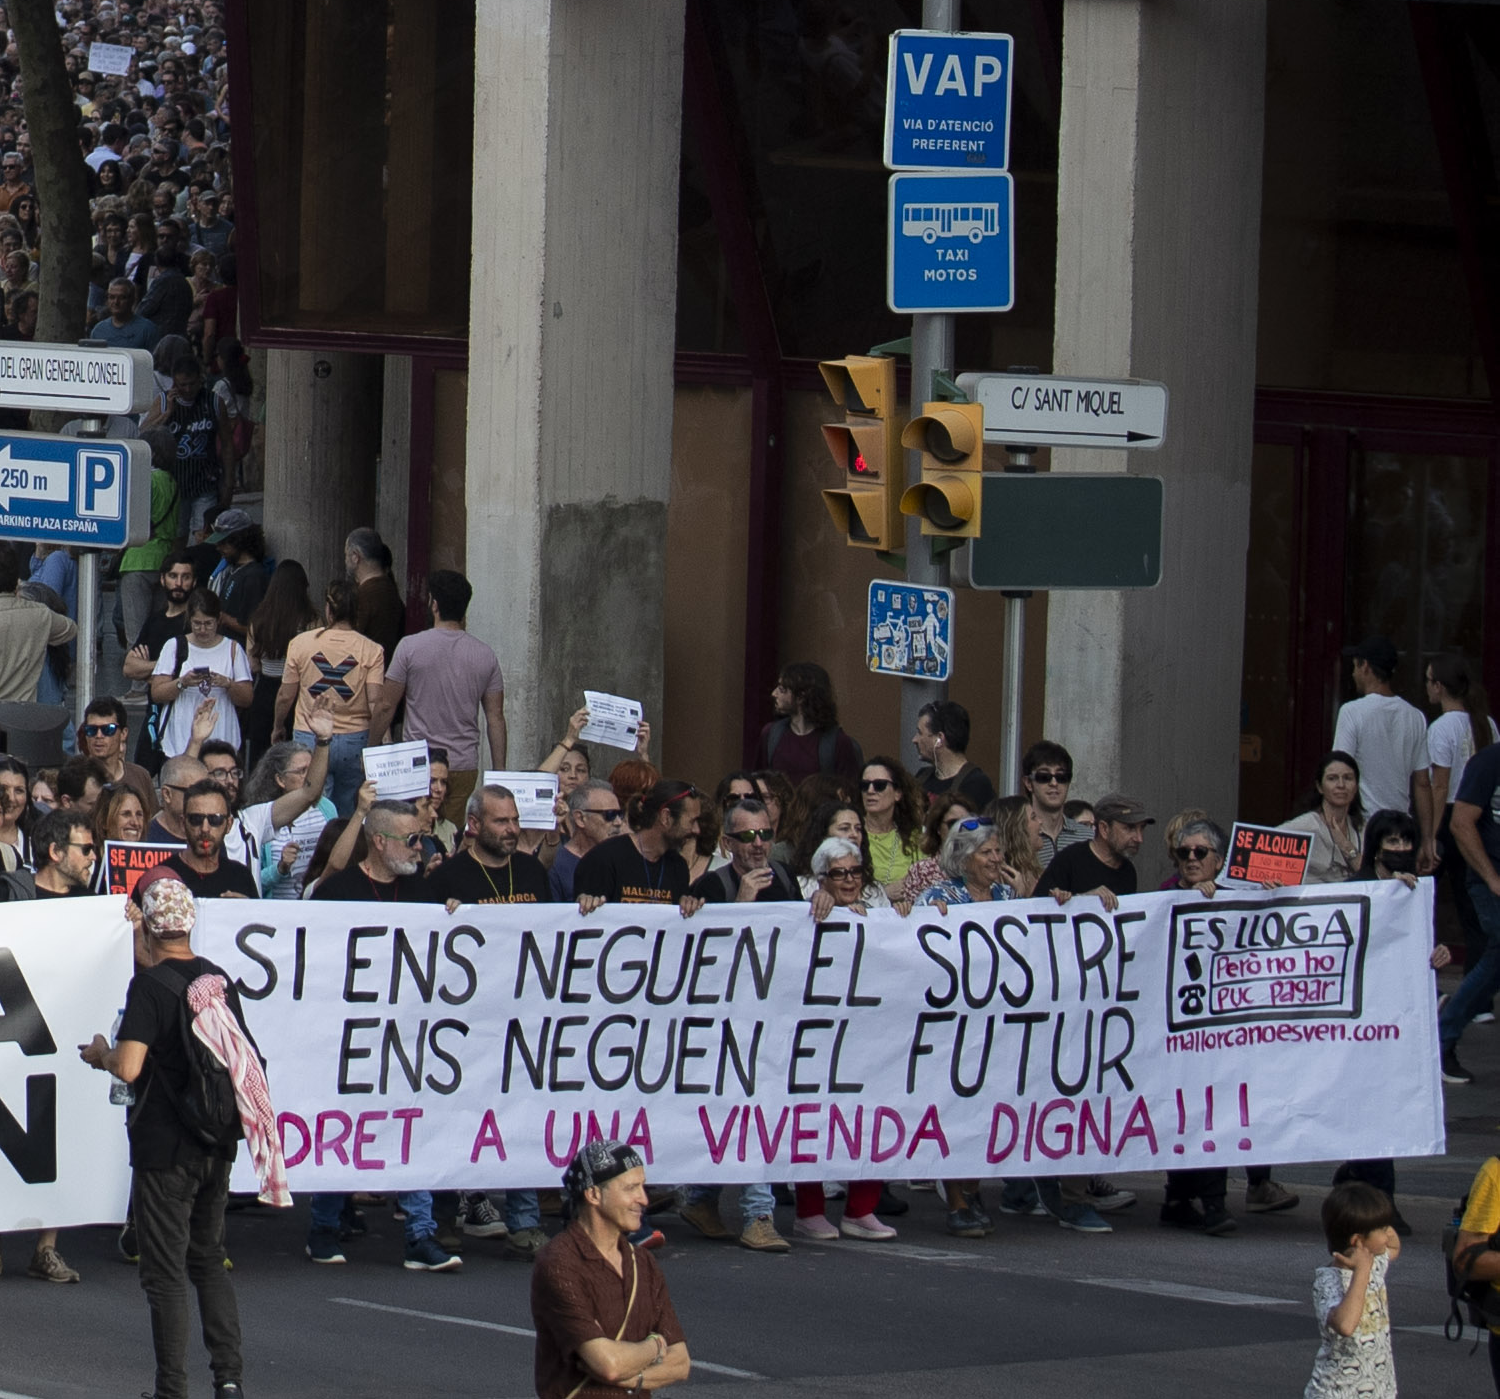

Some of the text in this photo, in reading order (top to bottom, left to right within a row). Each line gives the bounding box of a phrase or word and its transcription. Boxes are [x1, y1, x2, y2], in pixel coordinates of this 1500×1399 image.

[903, 53, 1003, 97] VAP
[903, 119, 994, 133] VIA D'ATENCIÓ
[912, 139, 986, 152] PREFERENT
[936, 249, 969, 262] TAXI
[924, 269, 978, 282] MOTOS
[0, 356, 18, 379] DEL
[19, 358, 44, 381] GRAN
[45, 359, 85, 384] GENERAL
[87, 361, 127, 386] CONSELL
[1011, 387, 1125, 417] C/ SANT MIQUEL
[176, 435, 208, 459] 32
[0, 467, 48, 491] 250 m
[85, 456, 115, 512] P
[33, 515, 61, 531] PLAZA
[62, 515, 99, 533] ESPAÑA
[110, 848, 126, 867] SE
[1236, 830, 1308, 857] SE ALQUILA
[622, 886, 672, 899] MALLORCA
[1183, 909, 1354, 951] ES LLOGA
[234, 911, 1147, 1009] SI ENS NEGUEN EL SOSTRE
[1216, 949, 1335, 980] Però no ho
[1217, 978, 1336, 1011] puc pagar
[338, 1007, 1135, 1098] ENS NEGUEN EL FUTUR
[1166, 1022, 1400, 1053] mallorcanoesven.com
[277, 1107, 424, 1170] DRET
[470, 1108, 507, 1163] A
[544, 1105, 655, 1168] UNA
[698, 1103, 951, 1165] VIVENDA
